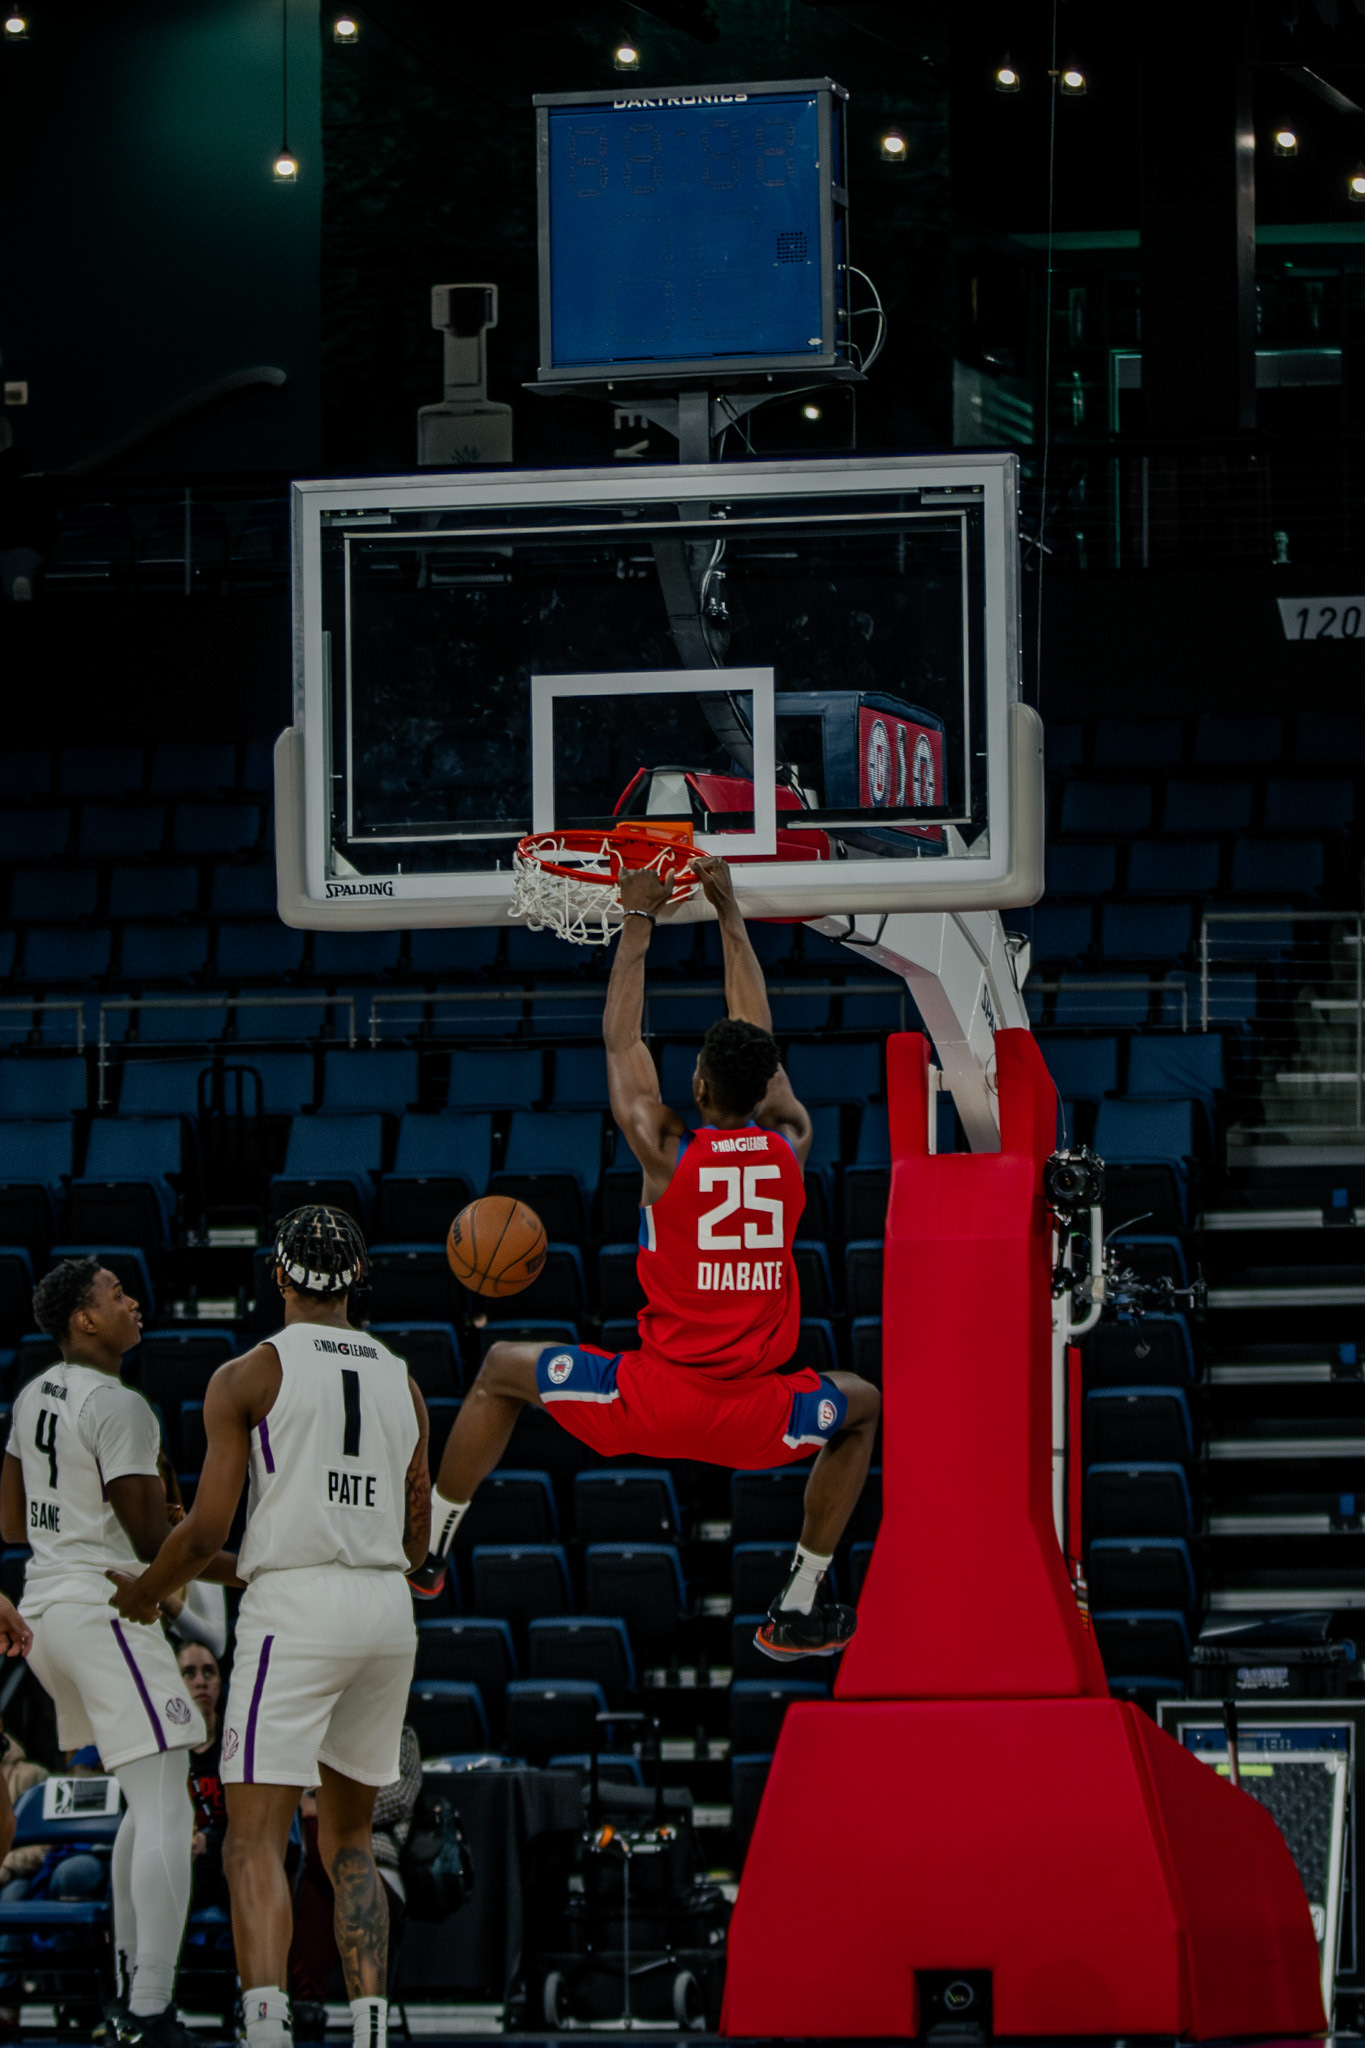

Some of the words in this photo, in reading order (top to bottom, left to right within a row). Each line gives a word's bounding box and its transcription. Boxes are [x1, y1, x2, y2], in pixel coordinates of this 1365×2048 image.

[1297, 606, 1361, 640] 120
[325, 881, 394, 899] SPALDING
[697, 1164, 784, 1251] 25
[697, 1261, 783, 1291] DIABATE
[341, 1369, 361, 1457] 1
[35, 1409, 58, 1489] 4
[328, 1471, 376, 1507] PATE
[31, 1502, 60, 1533] SANE
